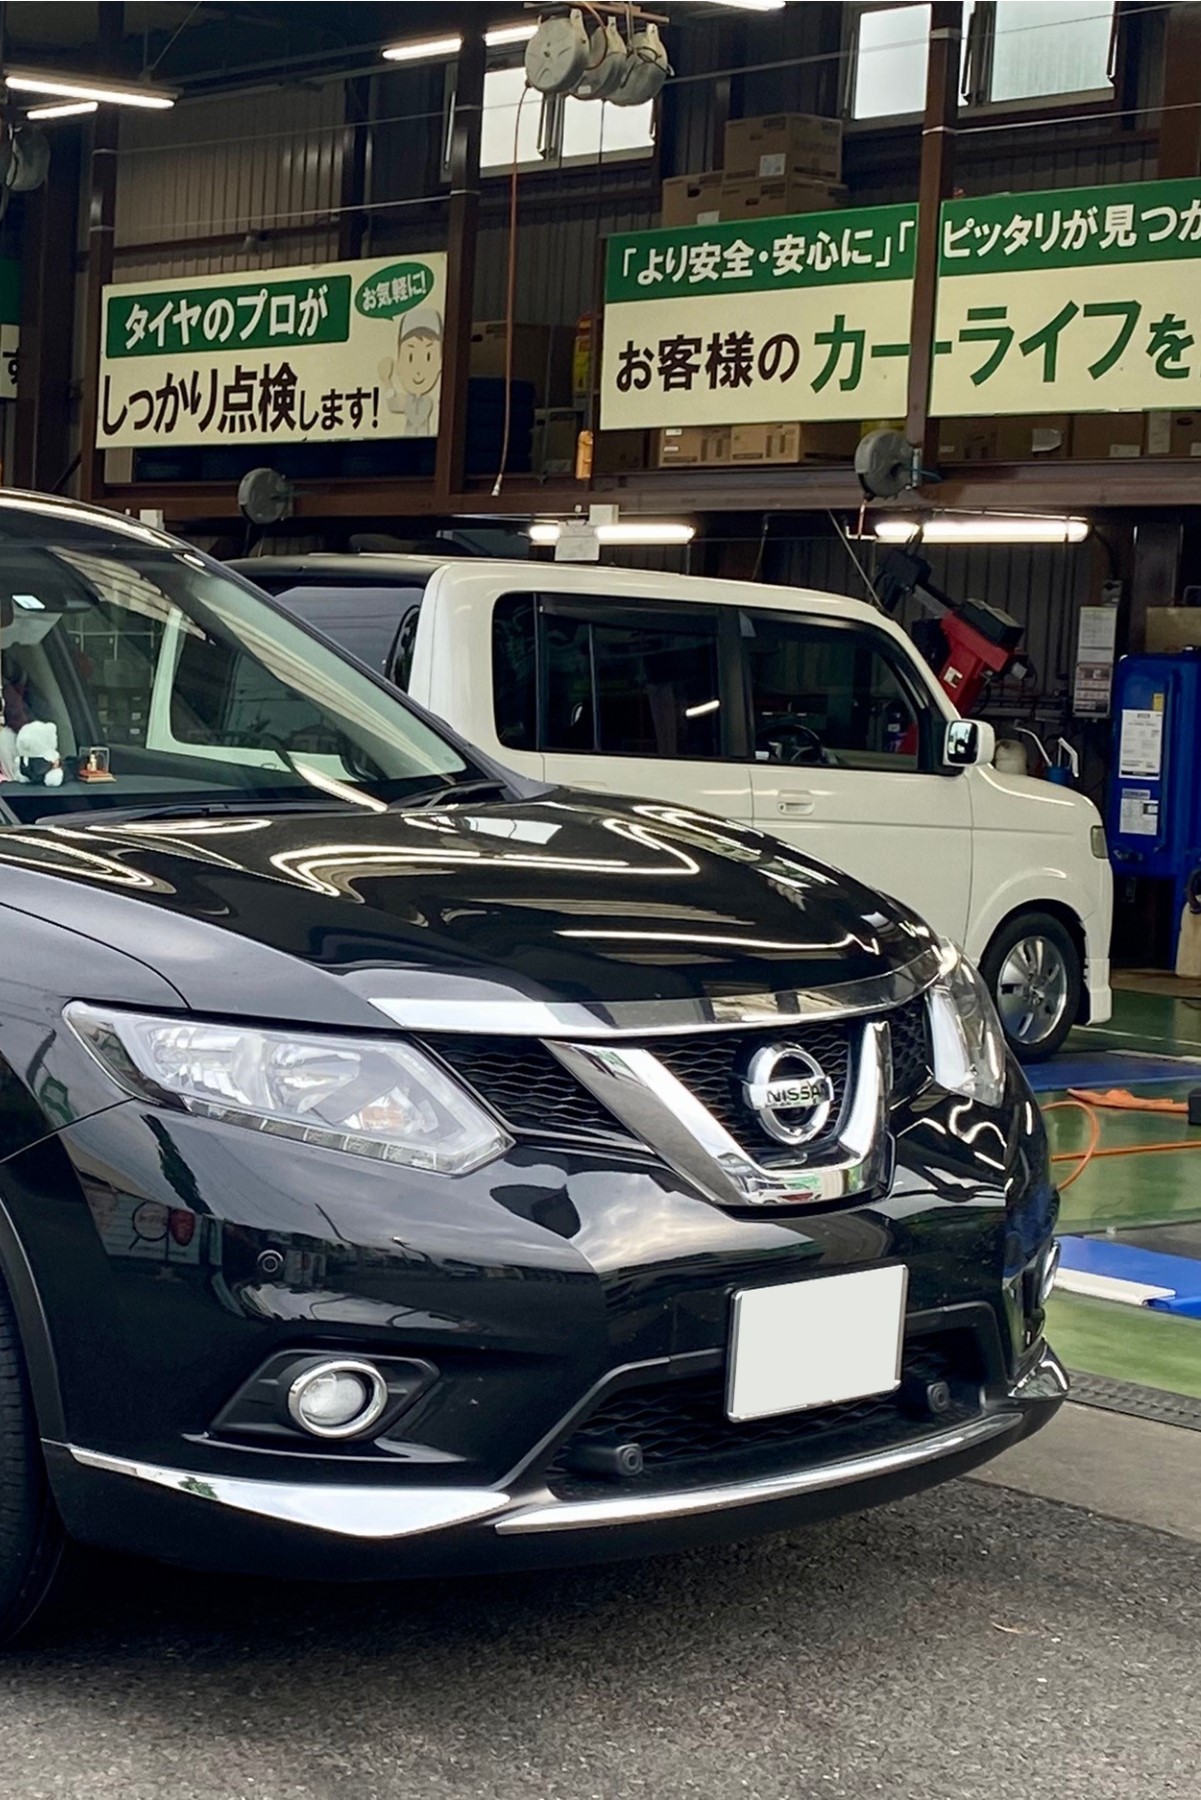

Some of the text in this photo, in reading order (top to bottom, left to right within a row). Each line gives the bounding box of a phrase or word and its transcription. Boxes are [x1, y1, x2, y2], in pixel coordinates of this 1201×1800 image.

[125, 283, 328, 350] タイヤのプロが
[362, 270, 427, 311] お気軽に!
[102, 362, 380, 436] しっかり点検します!
[766, 1084, 829, 1103] NISSA
